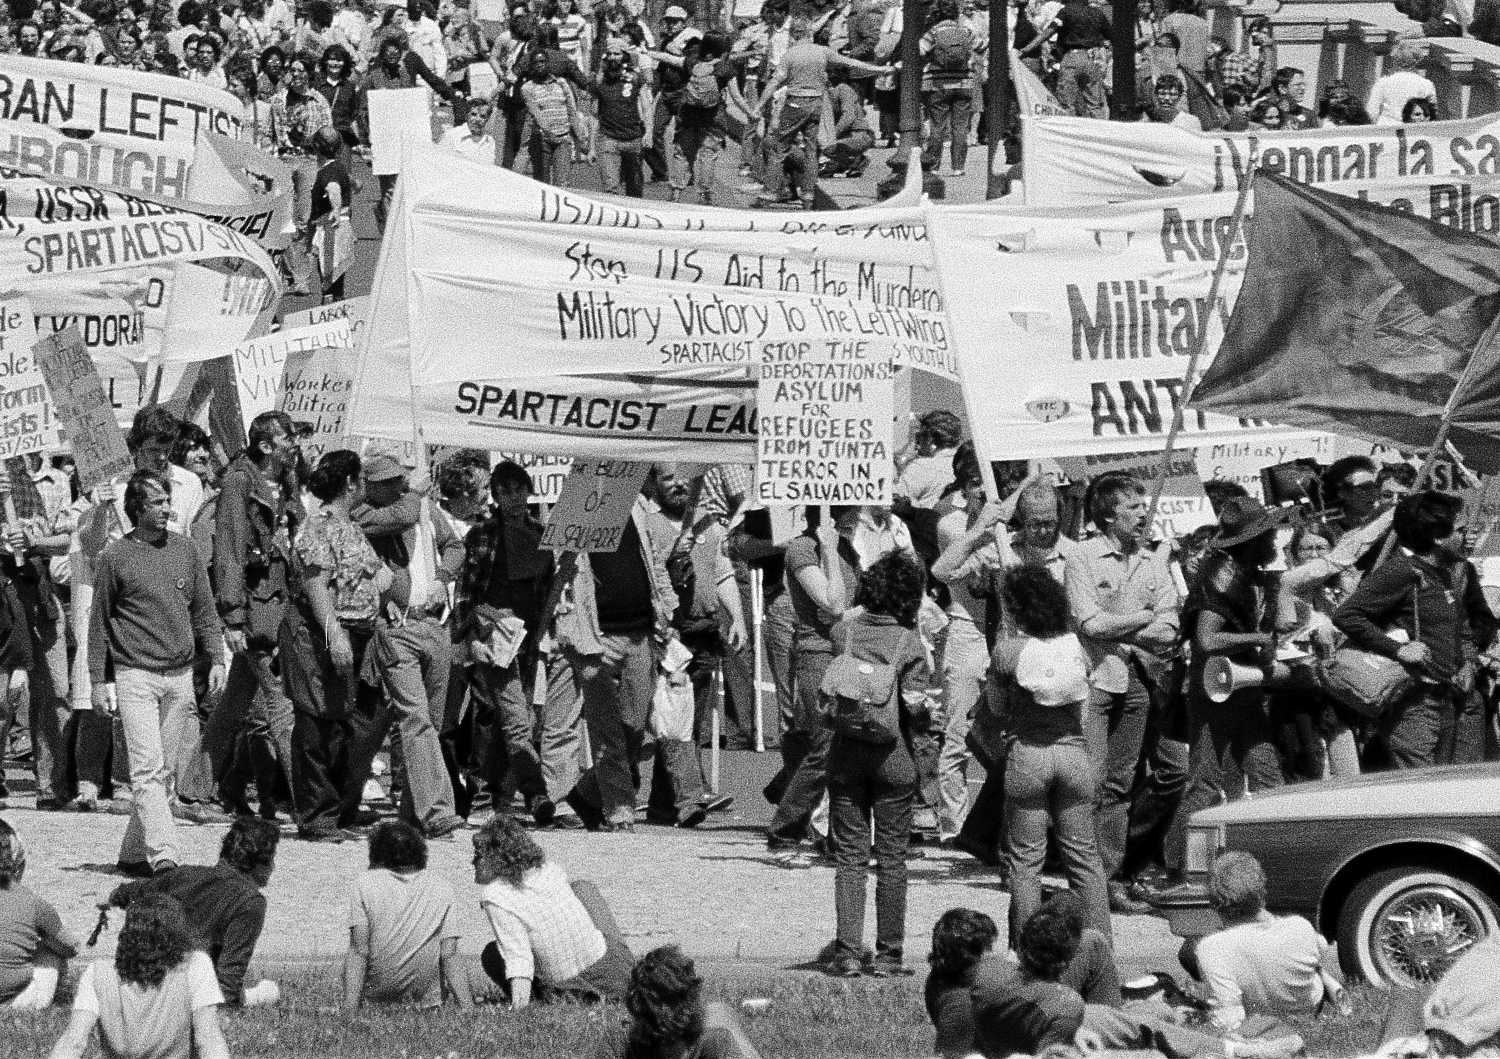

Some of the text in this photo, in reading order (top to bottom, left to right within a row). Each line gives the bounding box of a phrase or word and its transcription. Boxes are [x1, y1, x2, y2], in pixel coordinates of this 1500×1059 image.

[1395, 128, 1435, 177] la
[35, 185, 111, 225] USSR
[556, 289, 661, 345] Military
[673, 291, 769, 345] Victory
[660, 340, 754, 366] SPARTACIST
[761, 342, 812, 364] STOP
[825, 341, 869, 360] THE
[761, 357, 894, 380] DEPORTATIONS!
[773, 381, 863, 403] ASYLUM
[455, 381, 668, 433] SPARTACIST
[802, 402, 831, 418] FOR
[760, 415, 873, 440] REFUGEES
[763, 439, 887, 460] FROM JUNTA
[761, 459, 871, 480] TERROR IN
[759, 478, 885, 501] EL SALVADOR!
